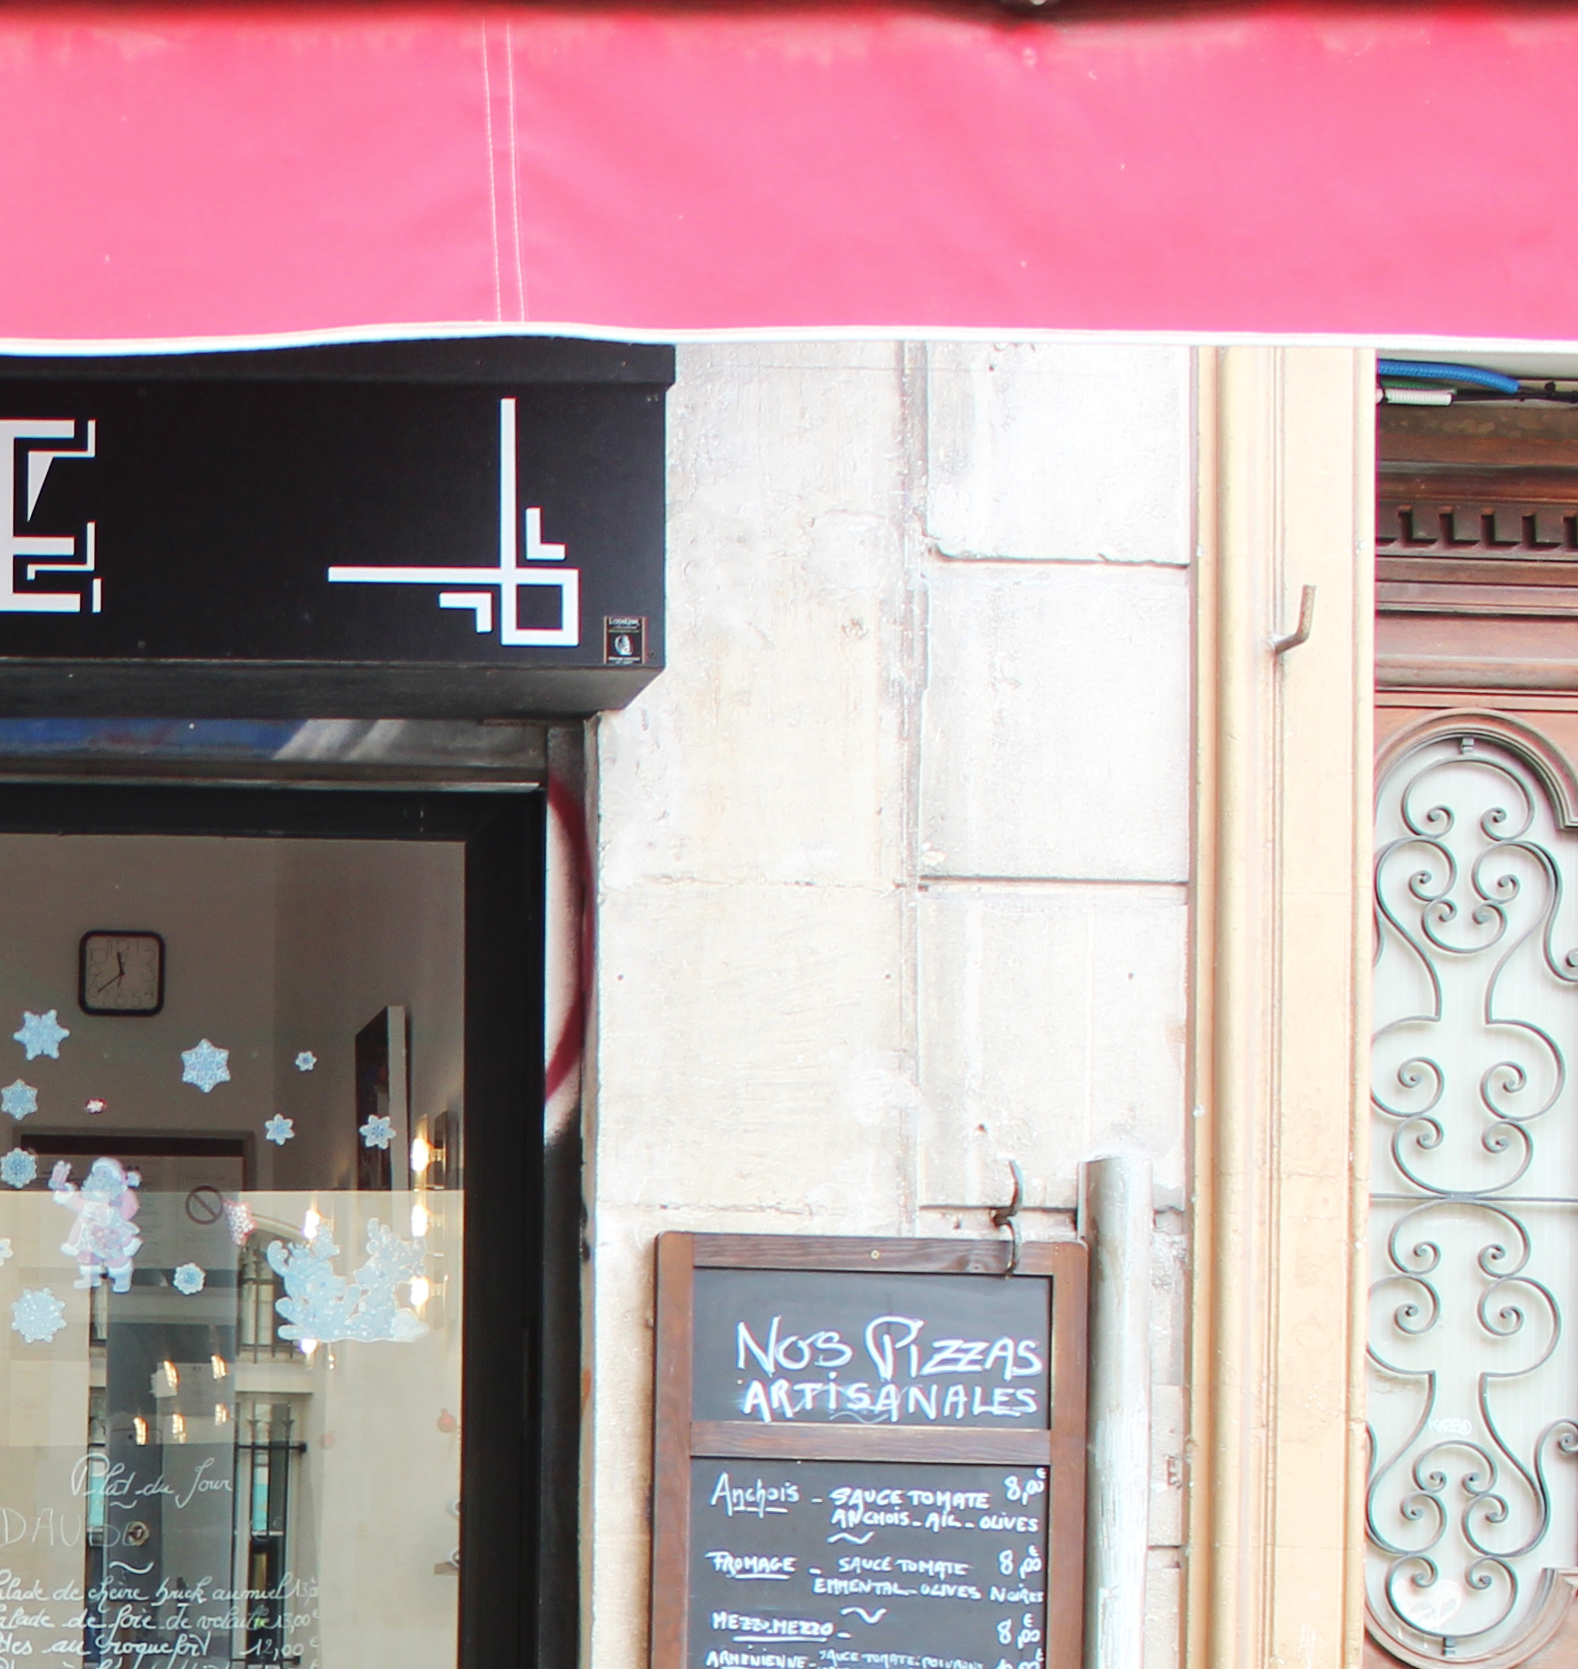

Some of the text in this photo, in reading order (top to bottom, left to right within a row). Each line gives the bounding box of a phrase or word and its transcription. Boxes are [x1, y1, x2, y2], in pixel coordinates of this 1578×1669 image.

[70, 1452, 131, 1497] Plat
[143, 1476, 175, 1497] du
[710, 1472, 800, 1518] Anchois
[829, 1486, 903, 1512] SAUCE
[907, 1489, 991, 1510] TOMATE
[705, 1550, 798, 1577] FROMAGE
[837, 1554, 893, 1574] SAUCE
[895, 1558, 974, 1580] TOMATE
[52, 1578, 85, 1602] de
[68, 1611, 105, 1631] de
[42, 1638, 91, 1656] au
